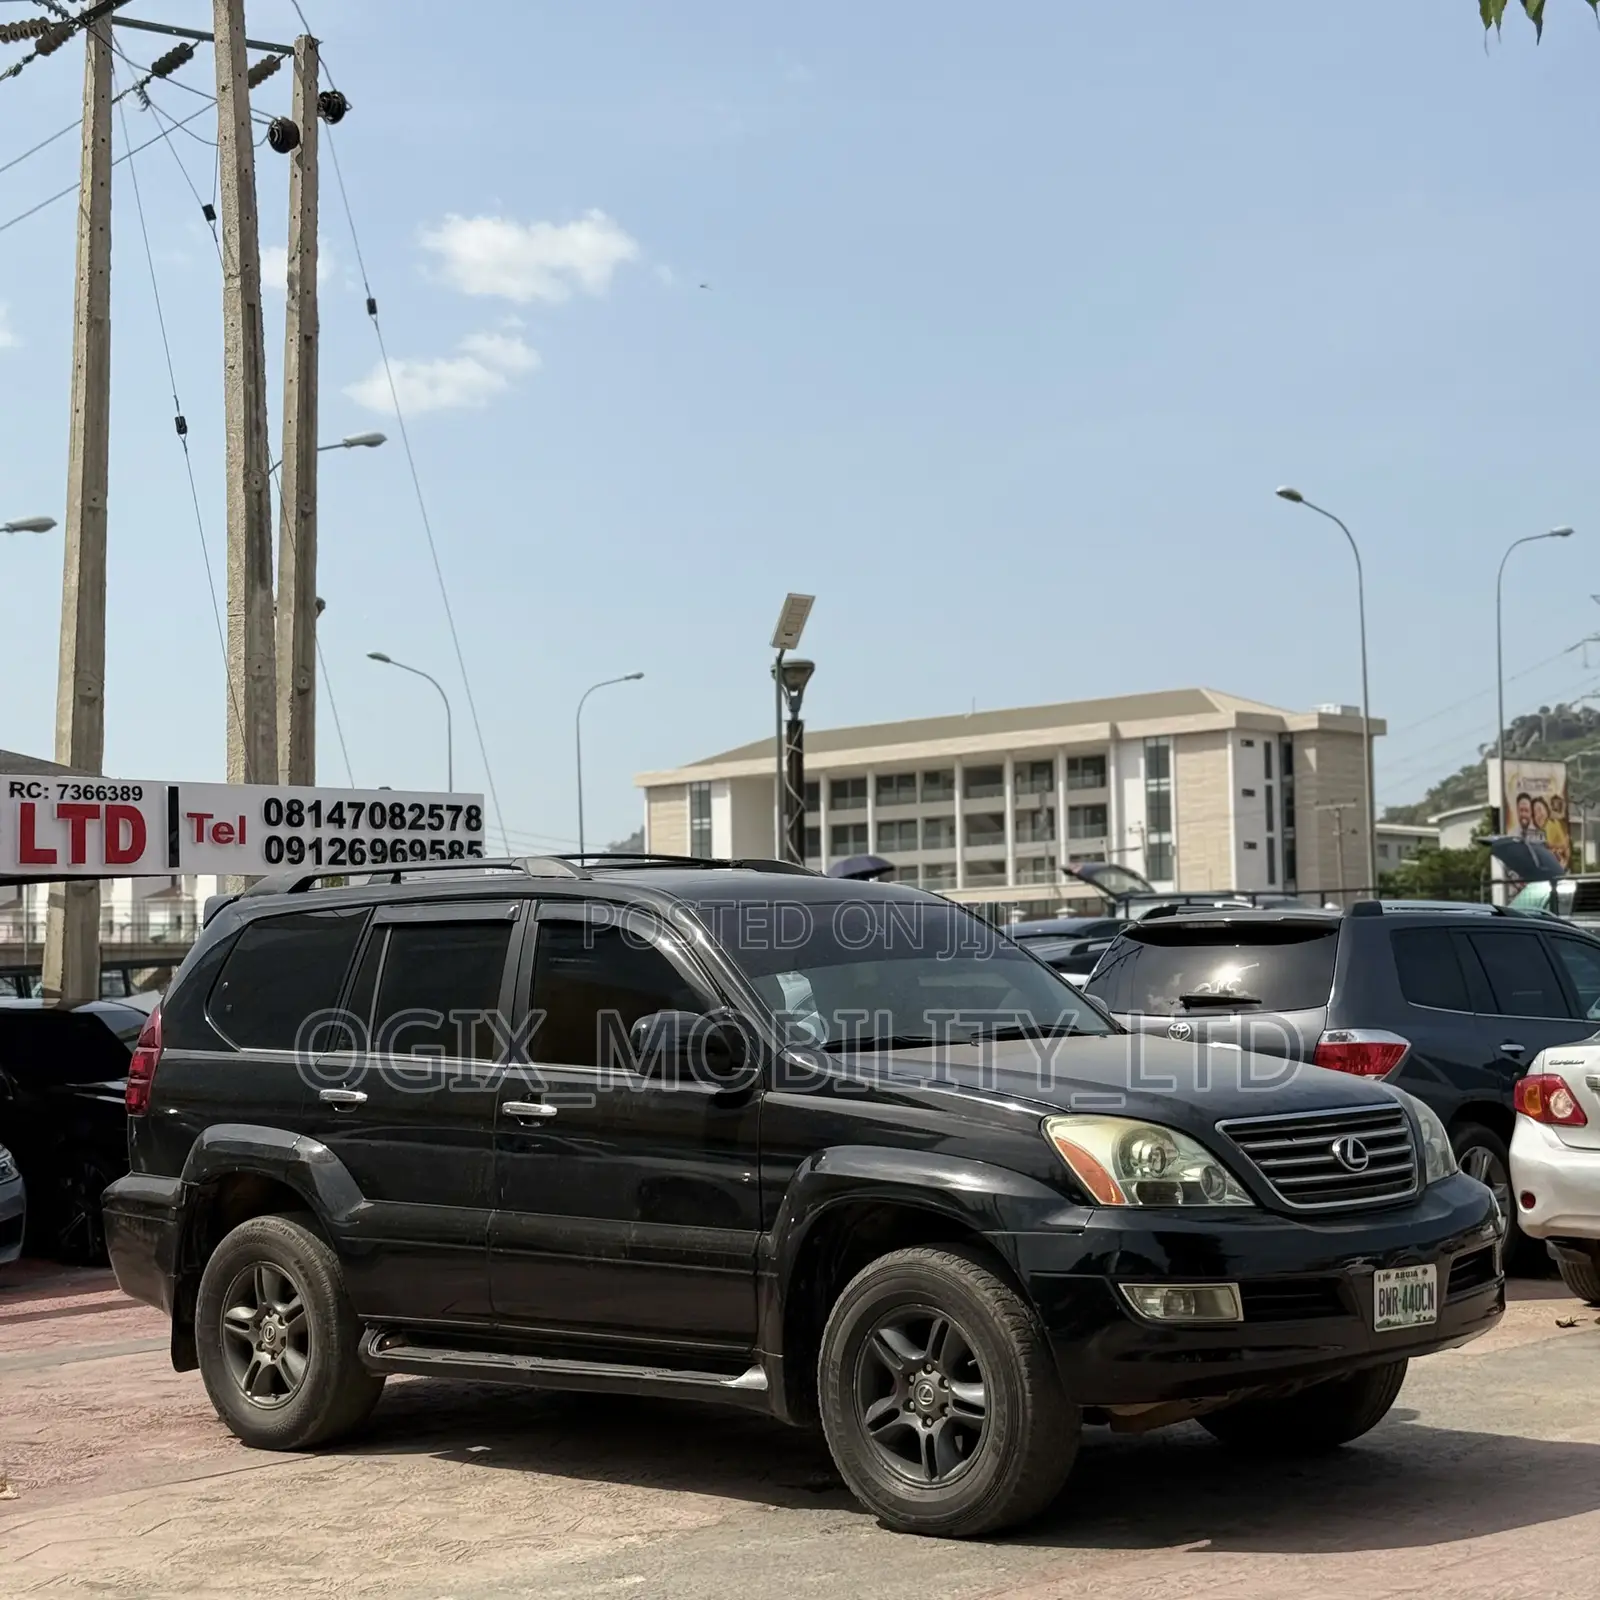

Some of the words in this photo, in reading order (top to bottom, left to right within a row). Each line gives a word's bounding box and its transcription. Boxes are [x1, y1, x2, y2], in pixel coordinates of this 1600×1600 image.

[9, 781, 50, 799] RC:
[56, 783, 143, 801] 7366389
[186, 812, 247, 845] Tel
[263, 797, 483, 832] 08147082578
[19, 802, 147, 865] LTD
[264, 835, 484, 866] 09126969585
